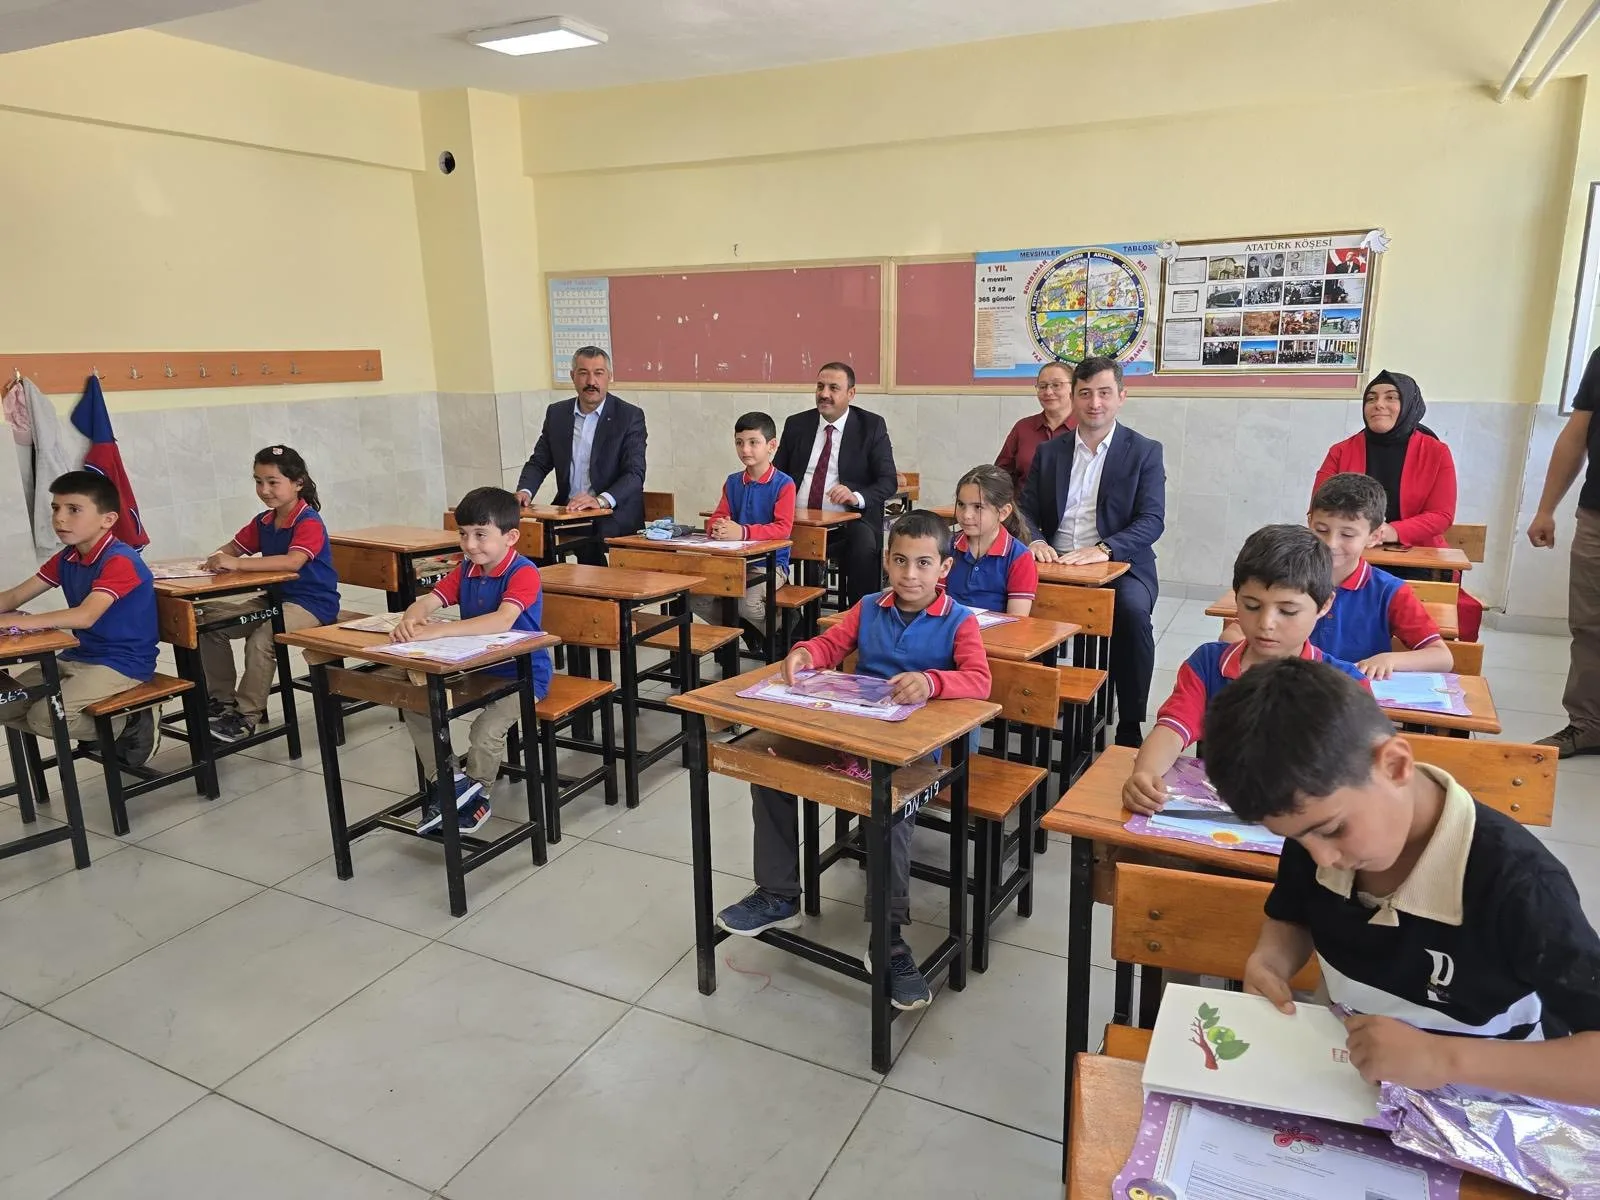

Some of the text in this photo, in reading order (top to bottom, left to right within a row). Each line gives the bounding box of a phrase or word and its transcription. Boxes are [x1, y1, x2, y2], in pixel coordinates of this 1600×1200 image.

[1245, 237, 1332, 251] ATATÜRK KÖŞESİ
[994, 264, 1008, 272] YIL
[987, 275, 1013, 283] mevsim
[1023, 260, 1048, 295] SONBAHAR
[992, 295, 1016, 304] gündür
